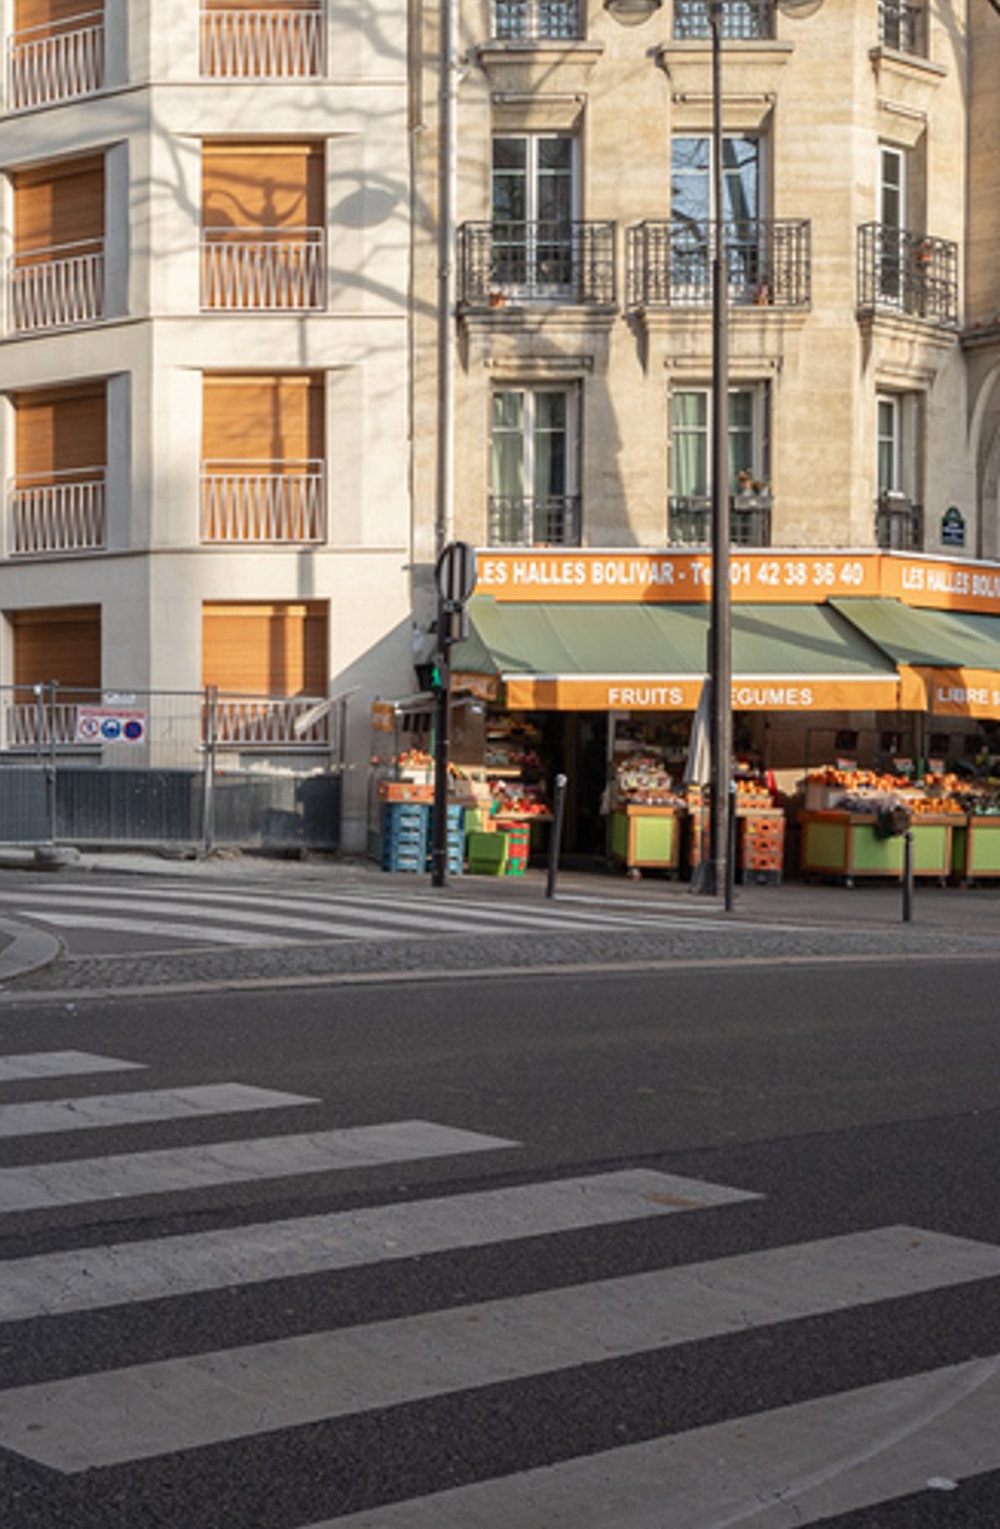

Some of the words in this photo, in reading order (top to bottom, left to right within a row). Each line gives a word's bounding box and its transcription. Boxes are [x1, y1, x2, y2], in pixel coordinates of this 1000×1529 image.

[477, 561, 507, 584] ES
[513, 561, 586, 584] HALLES
[592, 561, 674, 584] BOLIVAR
[729, 561, 750, 585] 01
[757, 561, 780, 585] 42
[784, 561, 808, 585] 38
[812, 561, 836, 585] 36
[840, 561, 864, 585] 40
[902, 567, 925, 589] LES
[927, 568, 969, 595] HALLES
[608, 687, 683, 705] FRUITS
[731, 687, 813, 705] EGUMES
[937, 686, 988, 705] LIBRE
